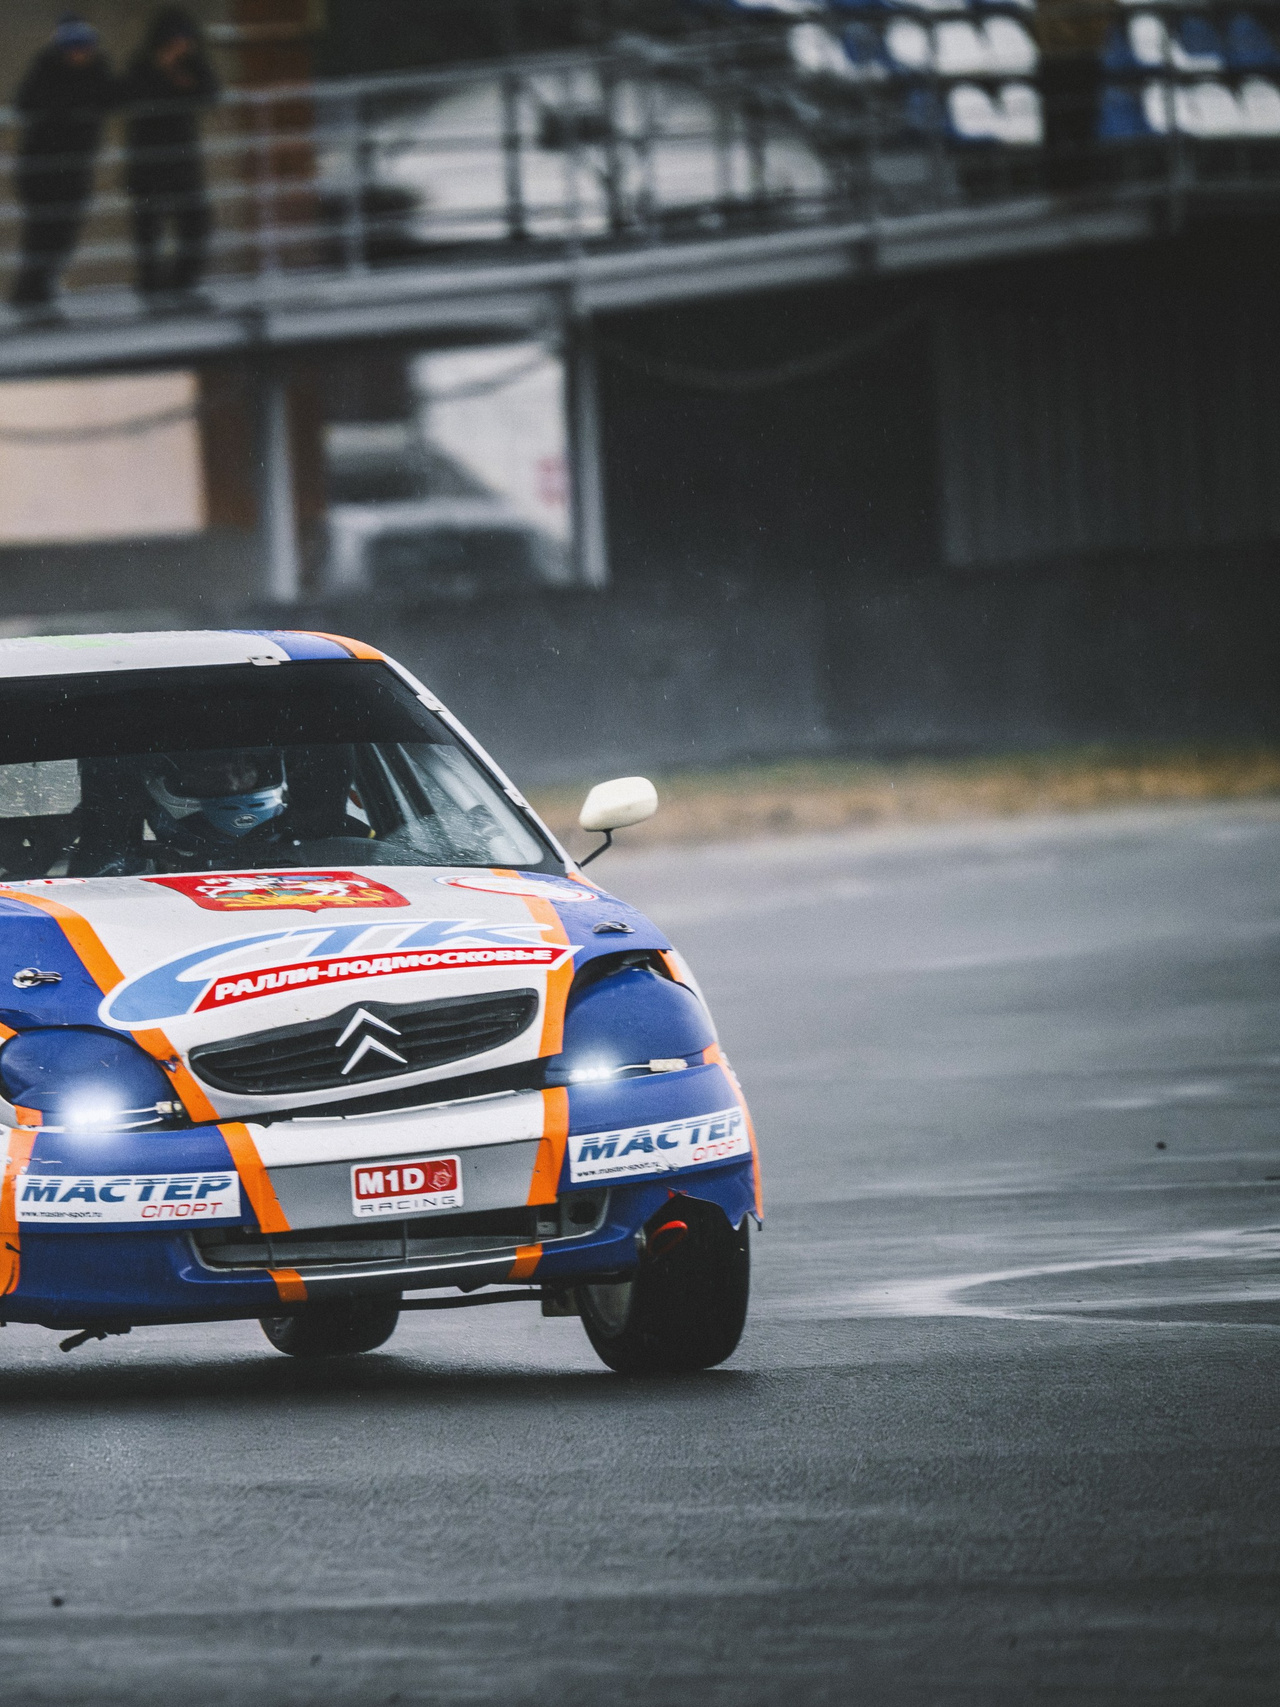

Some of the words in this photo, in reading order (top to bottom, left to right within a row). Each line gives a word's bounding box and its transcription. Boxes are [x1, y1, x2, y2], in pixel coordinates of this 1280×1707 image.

[109, 921, 546, 1022] СТК
[215, 949, 553, 1000] РАЛЛИ-ПОДМОСКОВЬЕ
[577, 1111, 741, 1163] МАСТЕР
[21, 1175, 232, 1203] МАСТЕР
[358, 1167, 425, 1195] M1D
[141, 1202, 223, 1218] СПОРТ
[360, 1196, 455, 1212] RACING
